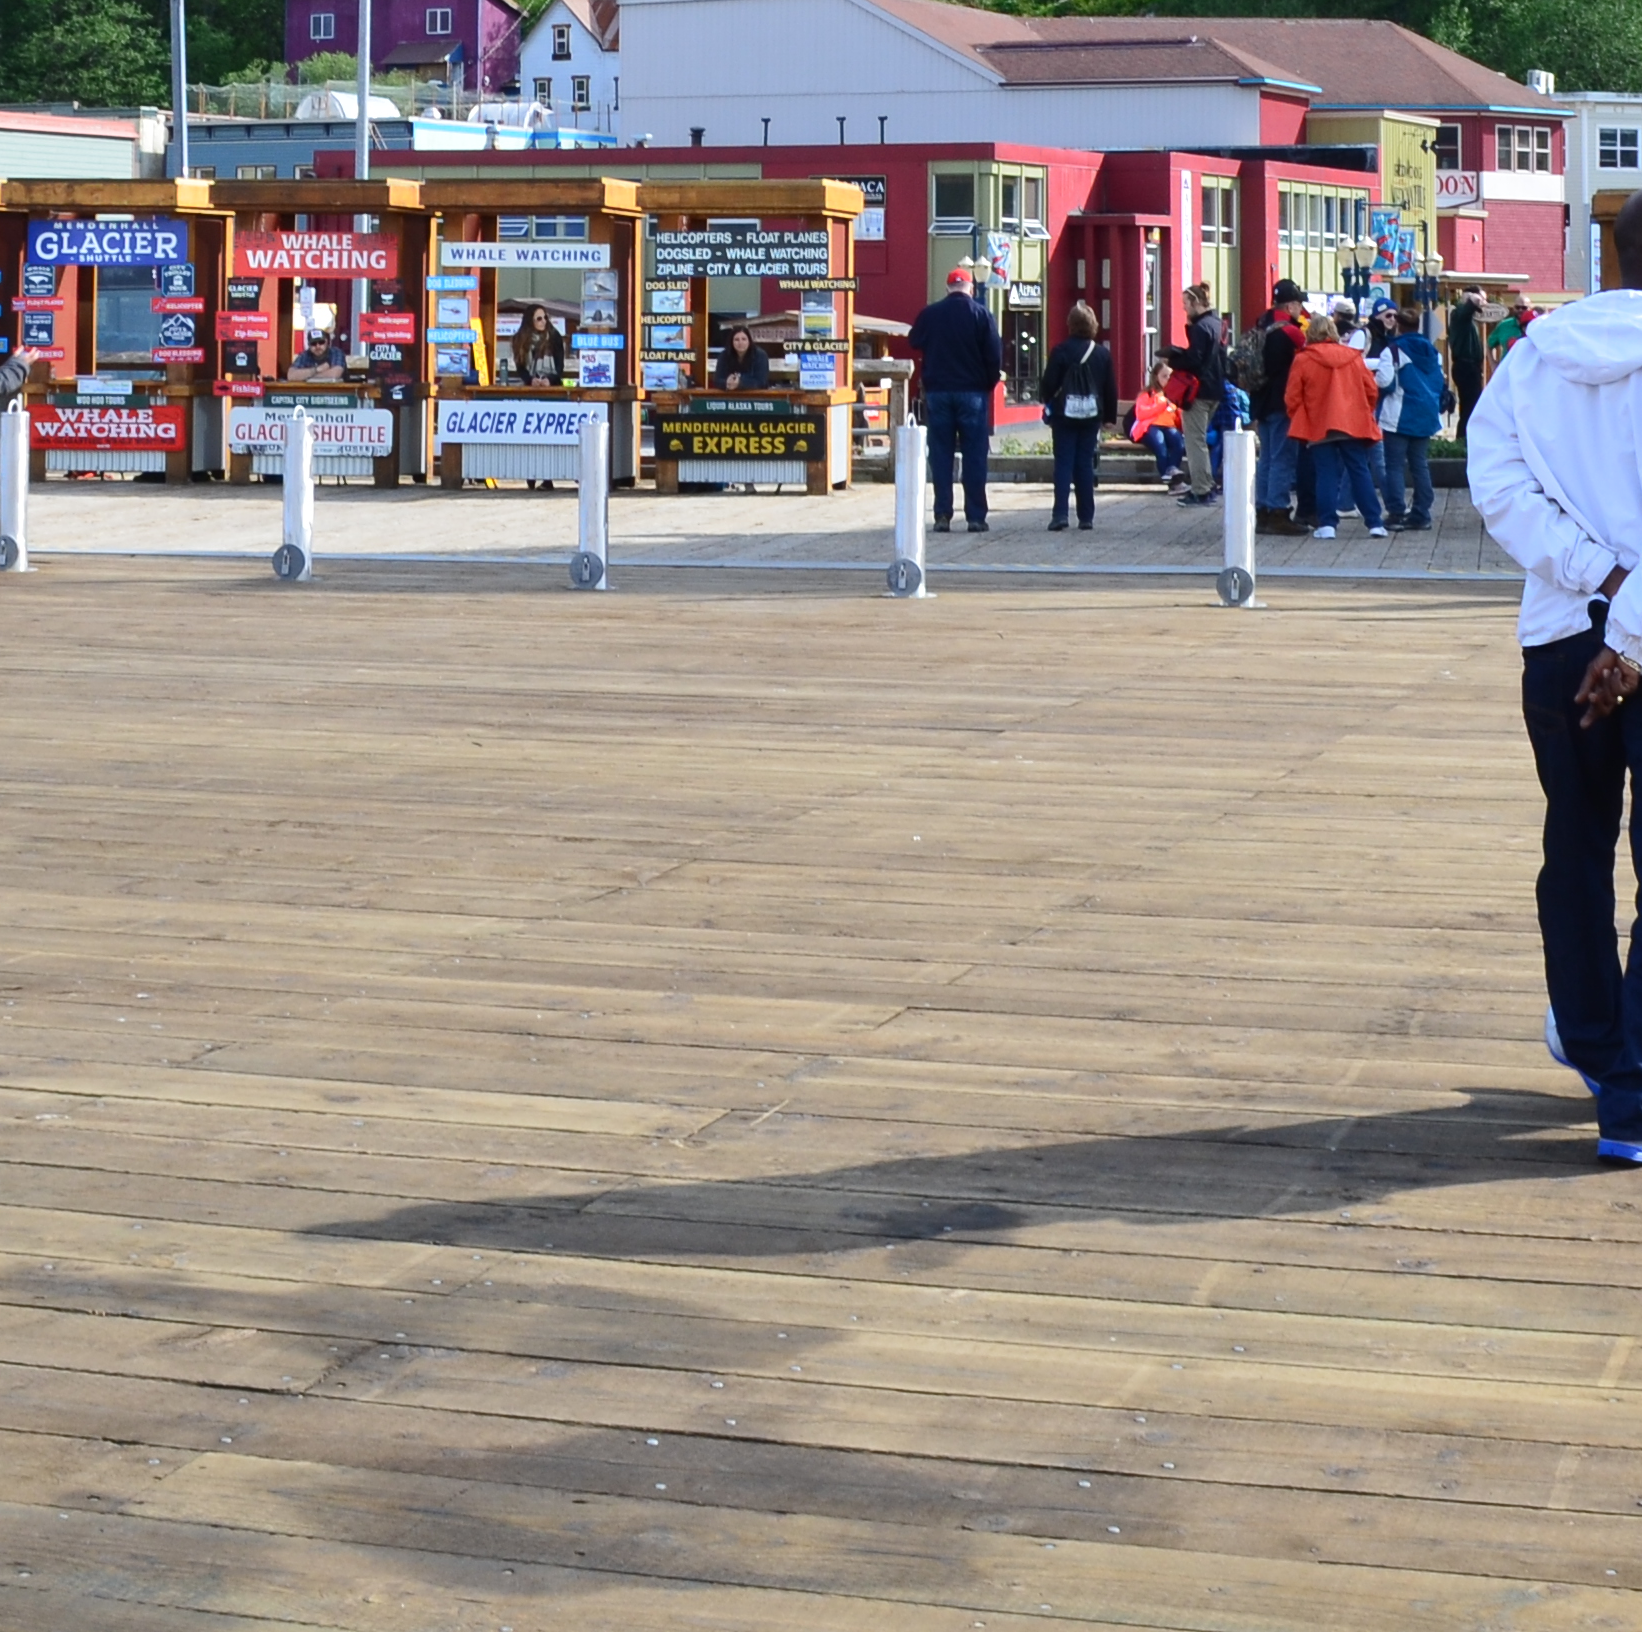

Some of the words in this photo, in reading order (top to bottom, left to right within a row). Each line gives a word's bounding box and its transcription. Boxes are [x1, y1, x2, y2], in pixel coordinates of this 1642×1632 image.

[54, 222, 160, 230] MENDENHALL
[280, 234, 353, 250] WHALE
[657, 232, 732, 244] HELICOPTERS
[746, 232, 780, 244] FLOAT
[784, 232, 827, 244] PLANES
[35, 232, 178, 260] GLACIER
[79, 254, 132, 262] SHUTTLE
[246, 250, 387, 269] WATCHING
[451, 248, 507, 261] WHALE
[515, 249, 602, 262] WATCHING
[657, 248, 711, 260] DOGSLED
[725, 248, 766, 260] WHALE
[770, 248, 828, 260] WATCHING
[657, 264, 694, 275] ZIPLINE
[707, 264, 730, 275] CITY
[733, 264, 741, 275] &
[745, 264, 790, 275] GLACIER
[793, 264, 828, 275] TOURS
[228, 285, 259, 293] GLACIER
[645, 281, 665, 290] DOG
[667, 281, 689, 290] SLED
[779, 280, 809, 289] WHALE
[810, 280, 856, 289] WATCHING
[641, 316, 693, 324] HELICOPTER
[427, 330, 477, 341] HELICOPTERS
[577, 336, 599, 347] BLUE
[602, 336, 619, 347] BUS
[783, 342, 803, 350] CITY
[804, 342, 811, 350] &
[812, 342, 850, 351] GLACIER
[375, 344, 389, 352] CITY
[370, 351, 402, 361] GLACIER
[640, 351, 666, 360] FLOAT
[667, 351, 696, 361] PLANE
[232, 383, 261, 395] Fishing
[76, 396, 90, 405] WOO
[91, 396, 105, 405] HOO
[106, 396, 125, 405] TOURS
[271, 395, 295, 405] CAPITAL
[296, 396, 309, 405] CITY
[706, 402, 726, 411] LIQUID
[728, 402, 752, 411] ALASKA
[754, 402, 774, 411] TOURS
[55, 408, 153, 424] WHALE
[446, 412, 518, 434] GLACIER
[522, 413, 598, 435] EXPRES
[662, 422, 755, 434] MENDENHALL
[759, 422, 816, 434] GLACIER
[35, 422, 177, 439] WATCHING
[235, 423, 285, 441] GLACI
[313, 425, 386, 443] SHUTTLE
[692, 437, 786, 454] EXPRESS
